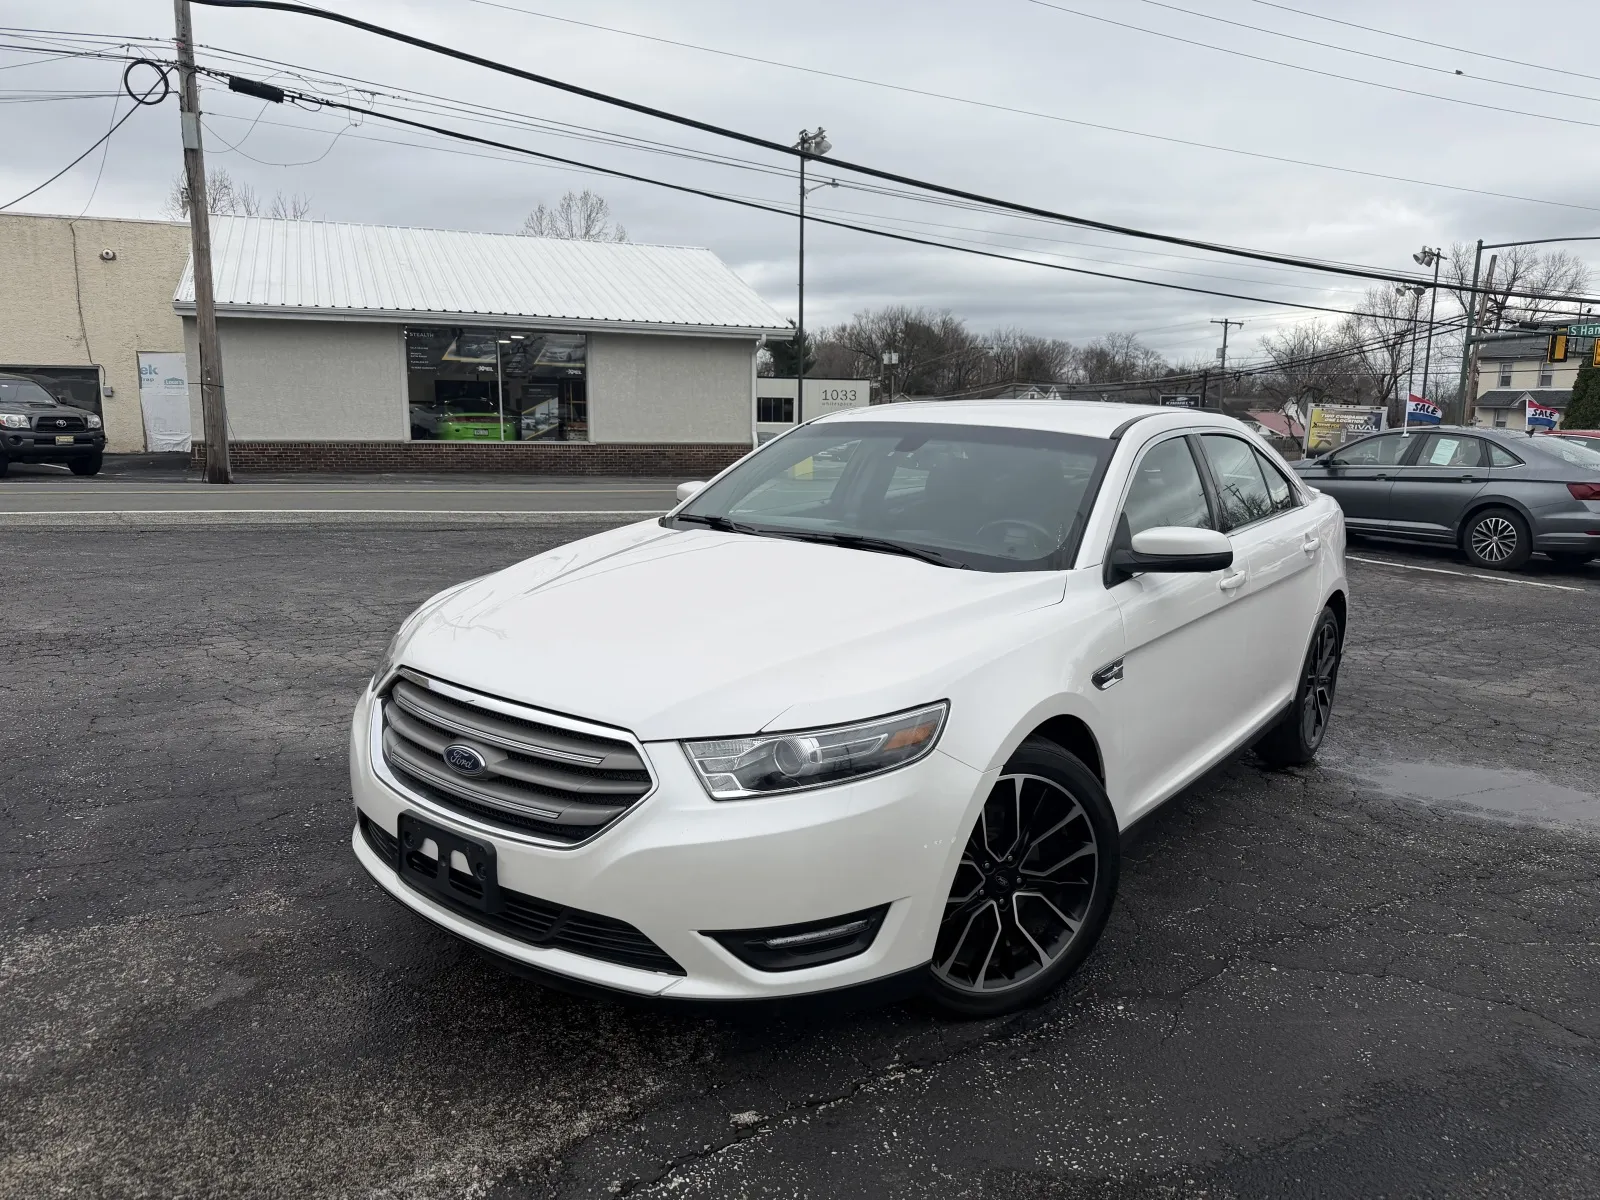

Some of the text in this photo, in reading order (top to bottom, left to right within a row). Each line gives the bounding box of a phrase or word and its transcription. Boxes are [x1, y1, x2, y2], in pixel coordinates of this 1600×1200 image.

[1570, 326, 1577, 336] S
[822, 389, 857, 401] 1033
[1413, 402, 1438, 415] SALE
[1531, 409, 1555, 419] SALE
[451, 750, 475, 768] Ford
